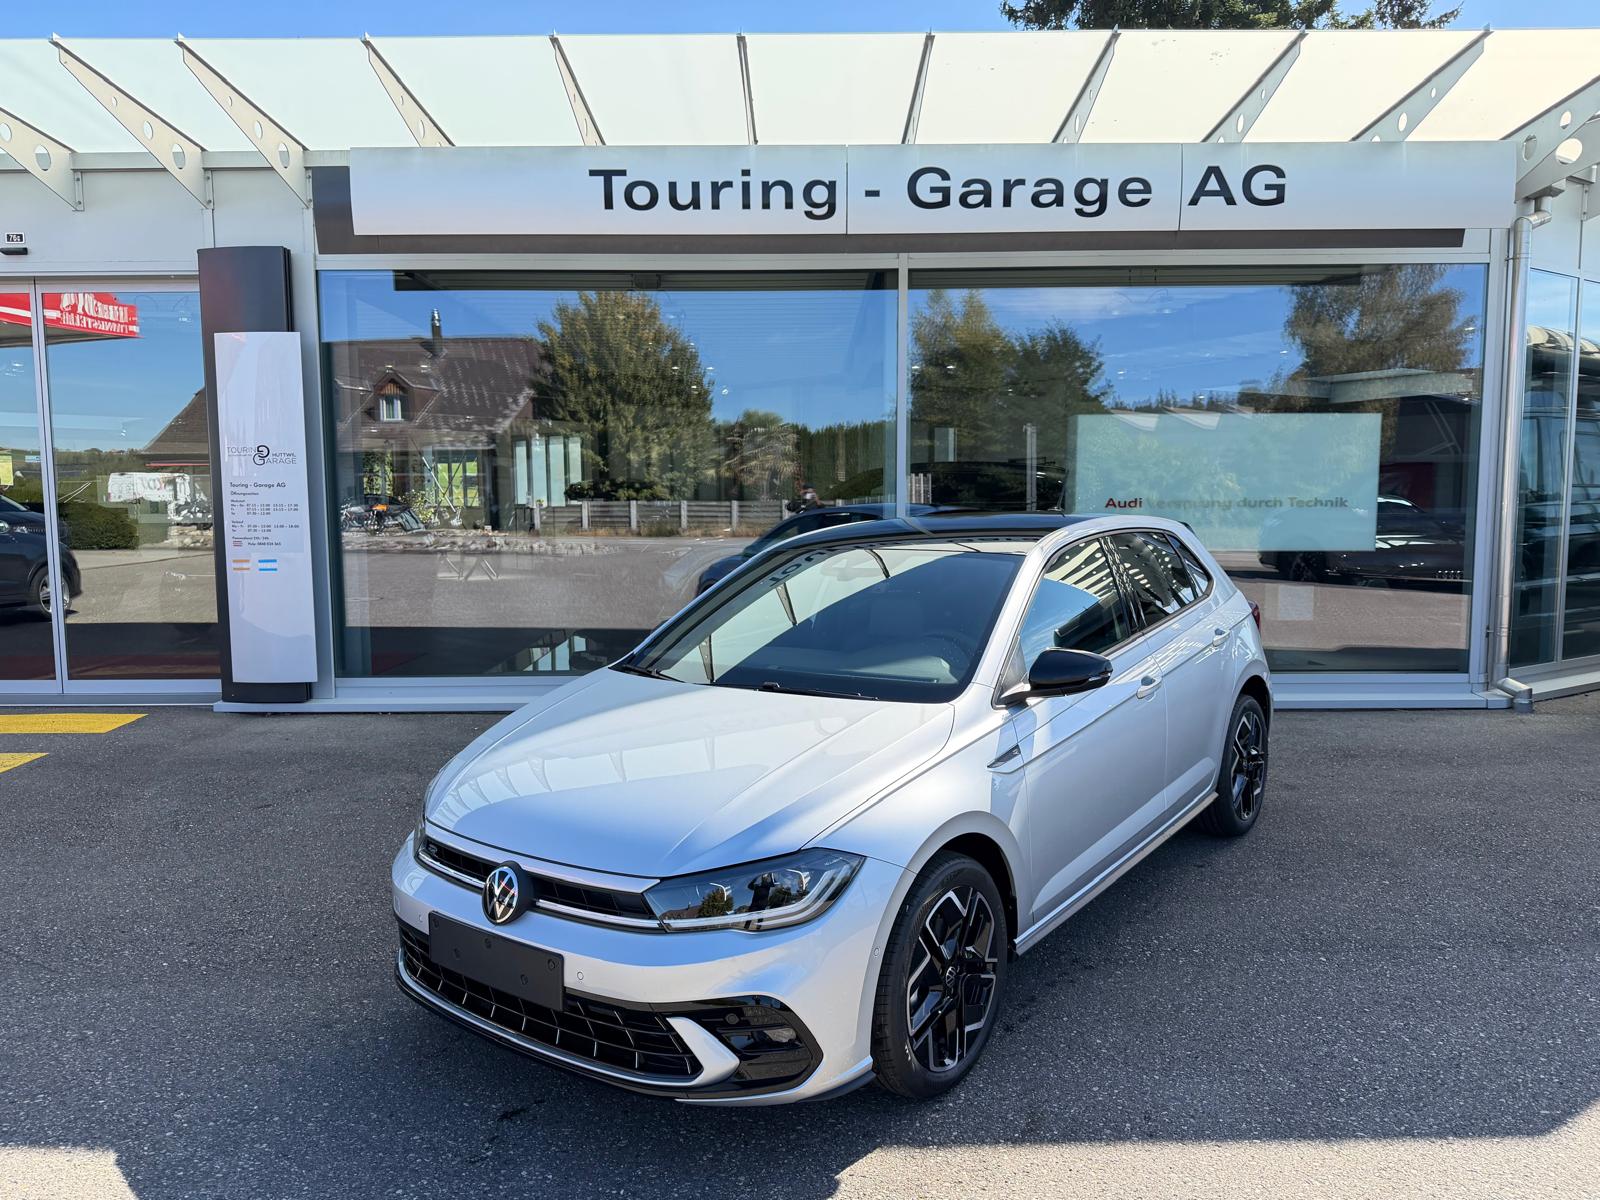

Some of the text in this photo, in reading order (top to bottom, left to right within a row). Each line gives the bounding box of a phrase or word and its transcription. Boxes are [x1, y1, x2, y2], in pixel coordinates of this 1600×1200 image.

[588, 163, 1287, 222] Touring - Garage AG
[1104, 497, 1144, 509] Audi
[1236, 496, 1283, 509] durch
[1287, 496, 1350, 509] Technik
